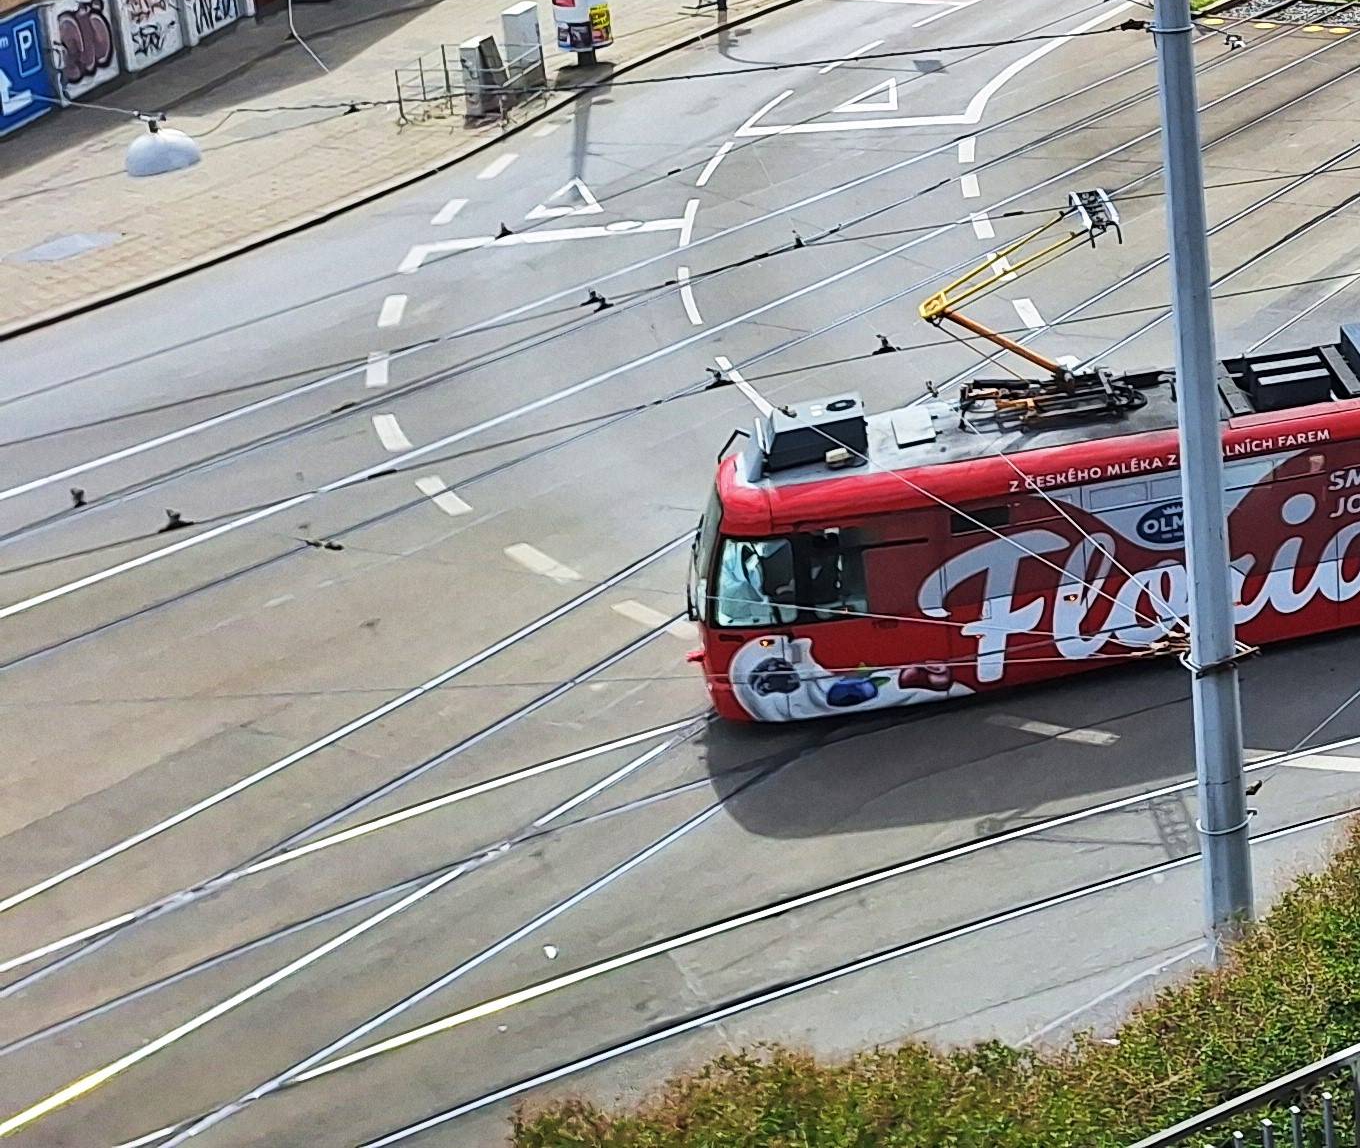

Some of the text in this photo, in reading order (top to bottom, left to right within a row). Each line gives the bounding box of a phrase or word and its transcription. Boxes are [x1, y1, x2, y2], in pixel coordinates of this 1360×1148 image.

[18, 30, 33, 61] P
[1278, 429, 1330, 447] FAREM
[1009, 454, 1177, 492] Z ČESKÉHO MLÉKA Z
[1143, 517, 1185, 534] OLM
